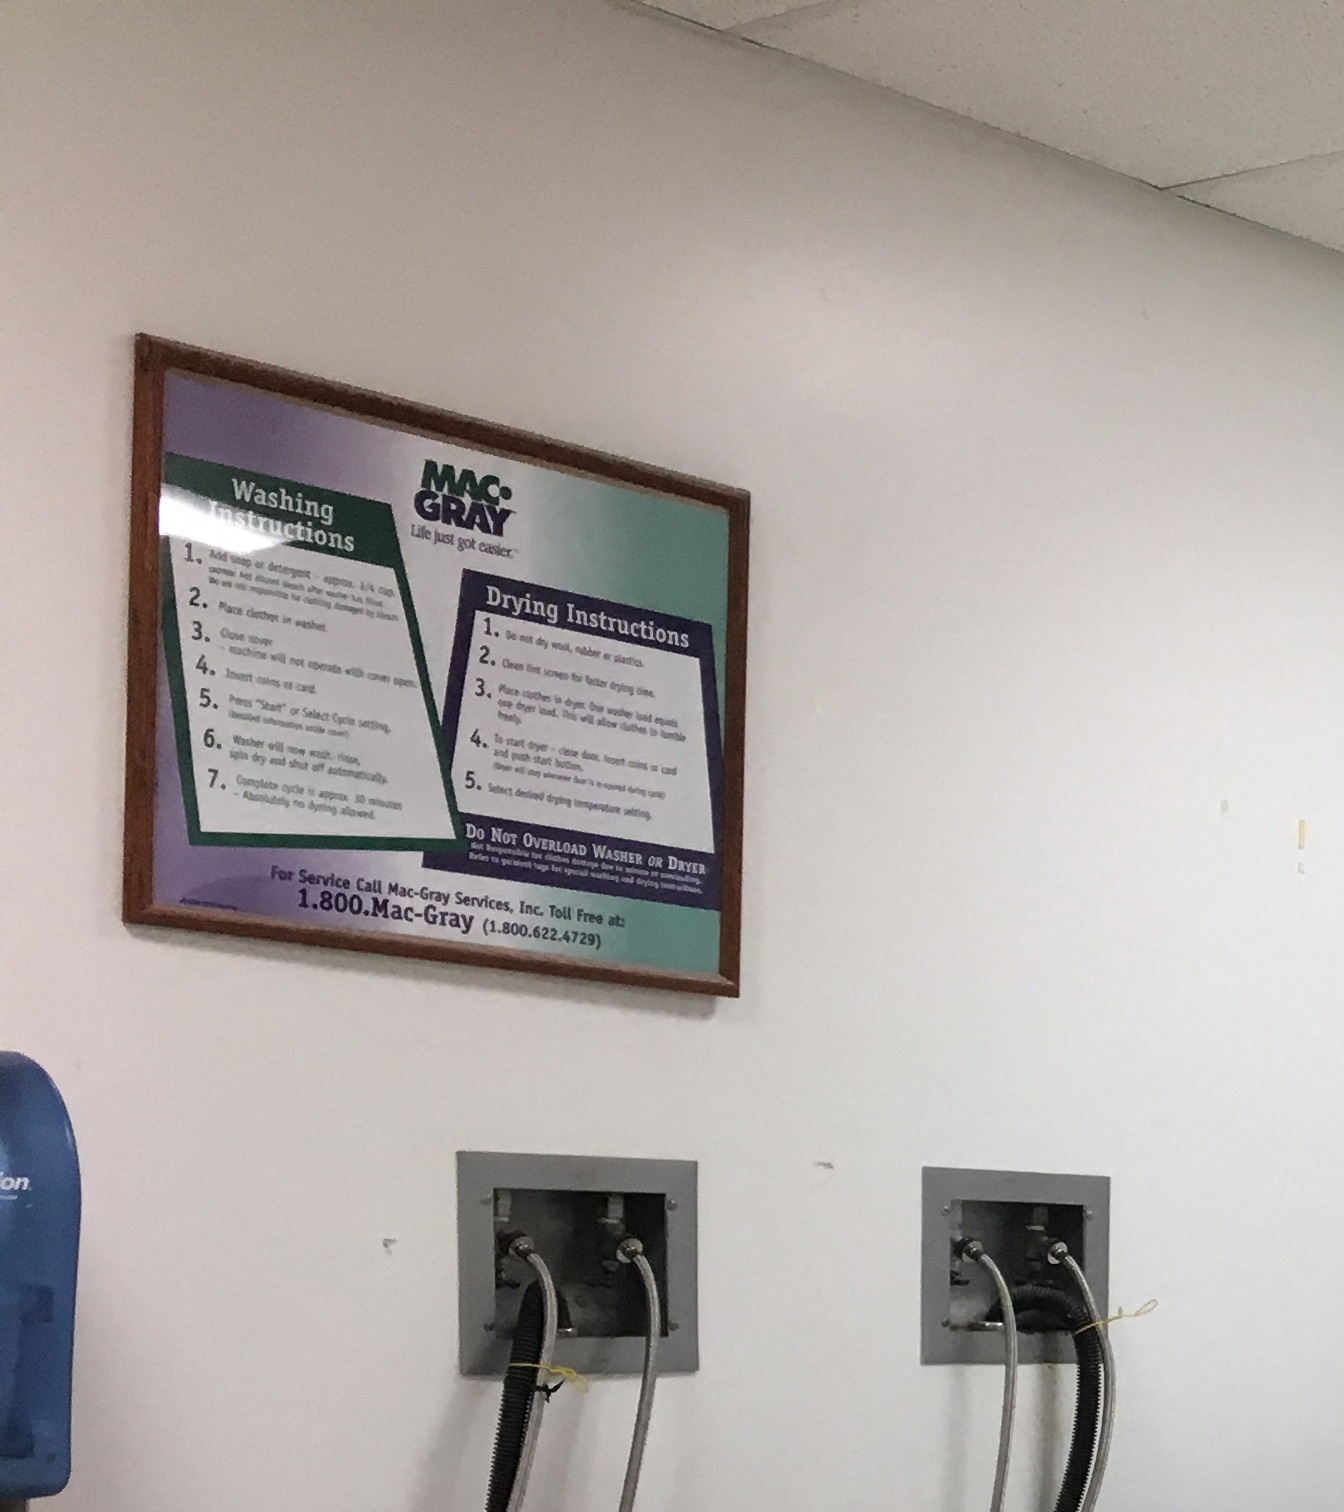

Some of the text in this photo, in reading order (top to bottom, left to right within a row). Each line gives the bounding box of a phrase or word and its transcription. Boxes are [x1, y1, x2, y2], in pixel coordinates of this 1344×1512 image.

[232, 478, 333, 526] Washing
[414, 489, 513, 537] GRAY
[208, 500, 354, 552] Instructions
[410, 524, 431, 541] Life
[433, 529, 454, 545] just
[458, 536, 475, 552] got
[185, 543, 202, 564] 1.
[189, 587, 208, 608] 2.
[486, 586, 690, 648] Drying Instructions
[191, 621, 210, 642] 3.
[483, 617, 500, 637] 1.
[506, 629, 517, 640] Do
[519, 633, 533, 644] not
[536, 636, 549, 649] dry
[196, 654, 215, 676] 4.
[479, 645, 496, 667] 2.
[474, 677, 492, 699] 3.
[199, 688, 219, 710] 5.
[302, 707, 329, 722] Select
[203, 729, 222, 749] 6.
[469, 728, 488, 749] 4.
[251, 752, 266, 766] dry
[208, 768, 226, 789] 7.
[464, 770, 481, 791] 5.
[270, 865, 293, 881] For
[299, 870, 351, 890] Service
[356, 877, 382, 894] Call
[388, 883, 449, 906] Mac-Gray
[455, 891, 514, 914] Services,
[519, 901, 543, 917] Inc.
[549, 905, 571, 921] Toll
[577, 909, 604, 924] Free
[298, 888, 602, 950] 1.800.Mac-Gray (1.800.622.4729)
